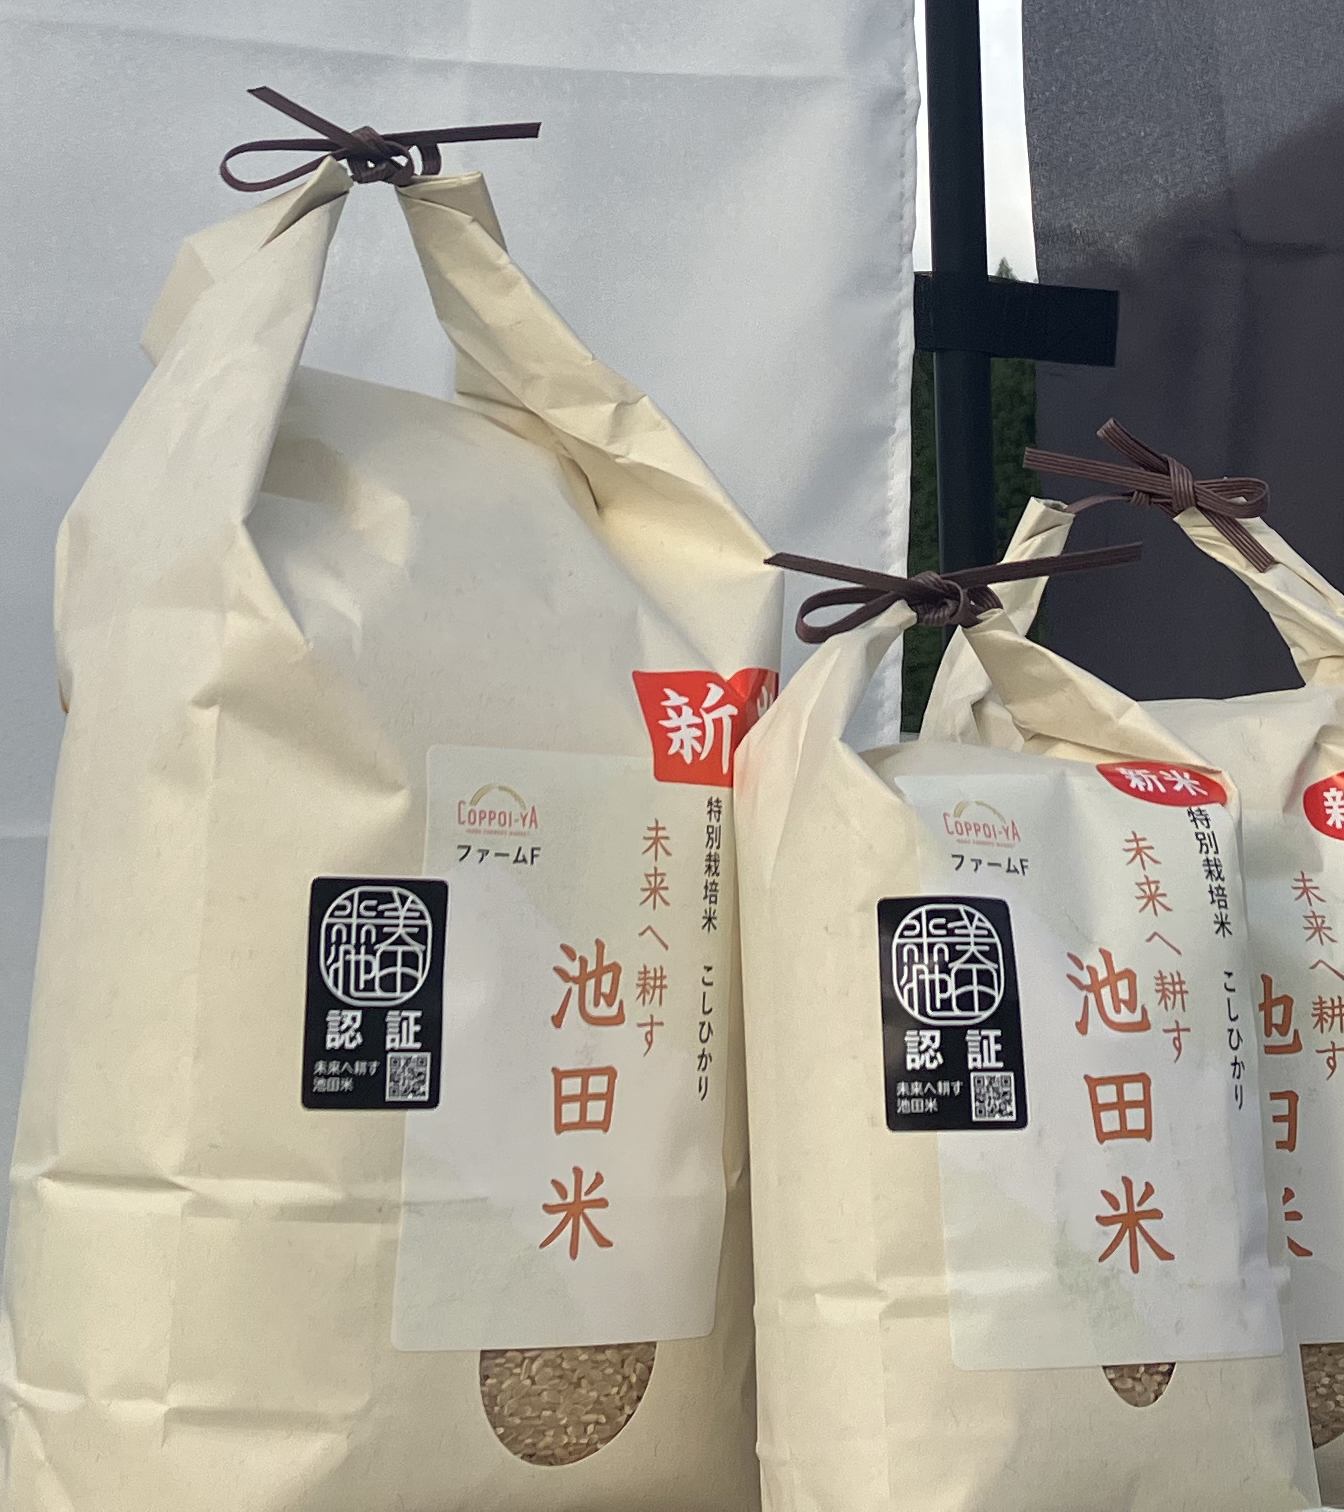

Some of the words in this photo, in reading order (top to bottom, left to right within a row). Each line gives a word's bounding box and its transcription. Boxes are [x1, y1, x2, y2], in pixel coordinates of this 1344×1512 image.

[457, 844, 542, 866] ファームF
[700, 796, 723, 933] 特別栽培米
[951, 854, 1029, 876] ファームF
[1124, 765, 1208, 797] 新米
[635, 817, 673, 1057] 未来へ耕す
[1122, 831, 1191, 1064] 未来へ耕す
[1187, 806, 1233, 938] 特別栽培米
[1223, 970, 1245, 1110] こしひかり
[539, 938, 626, 1260] 池田米
[696, 964, 716, 1102] こしひかり
[1066, 948, 1175, 1274] 池田米
